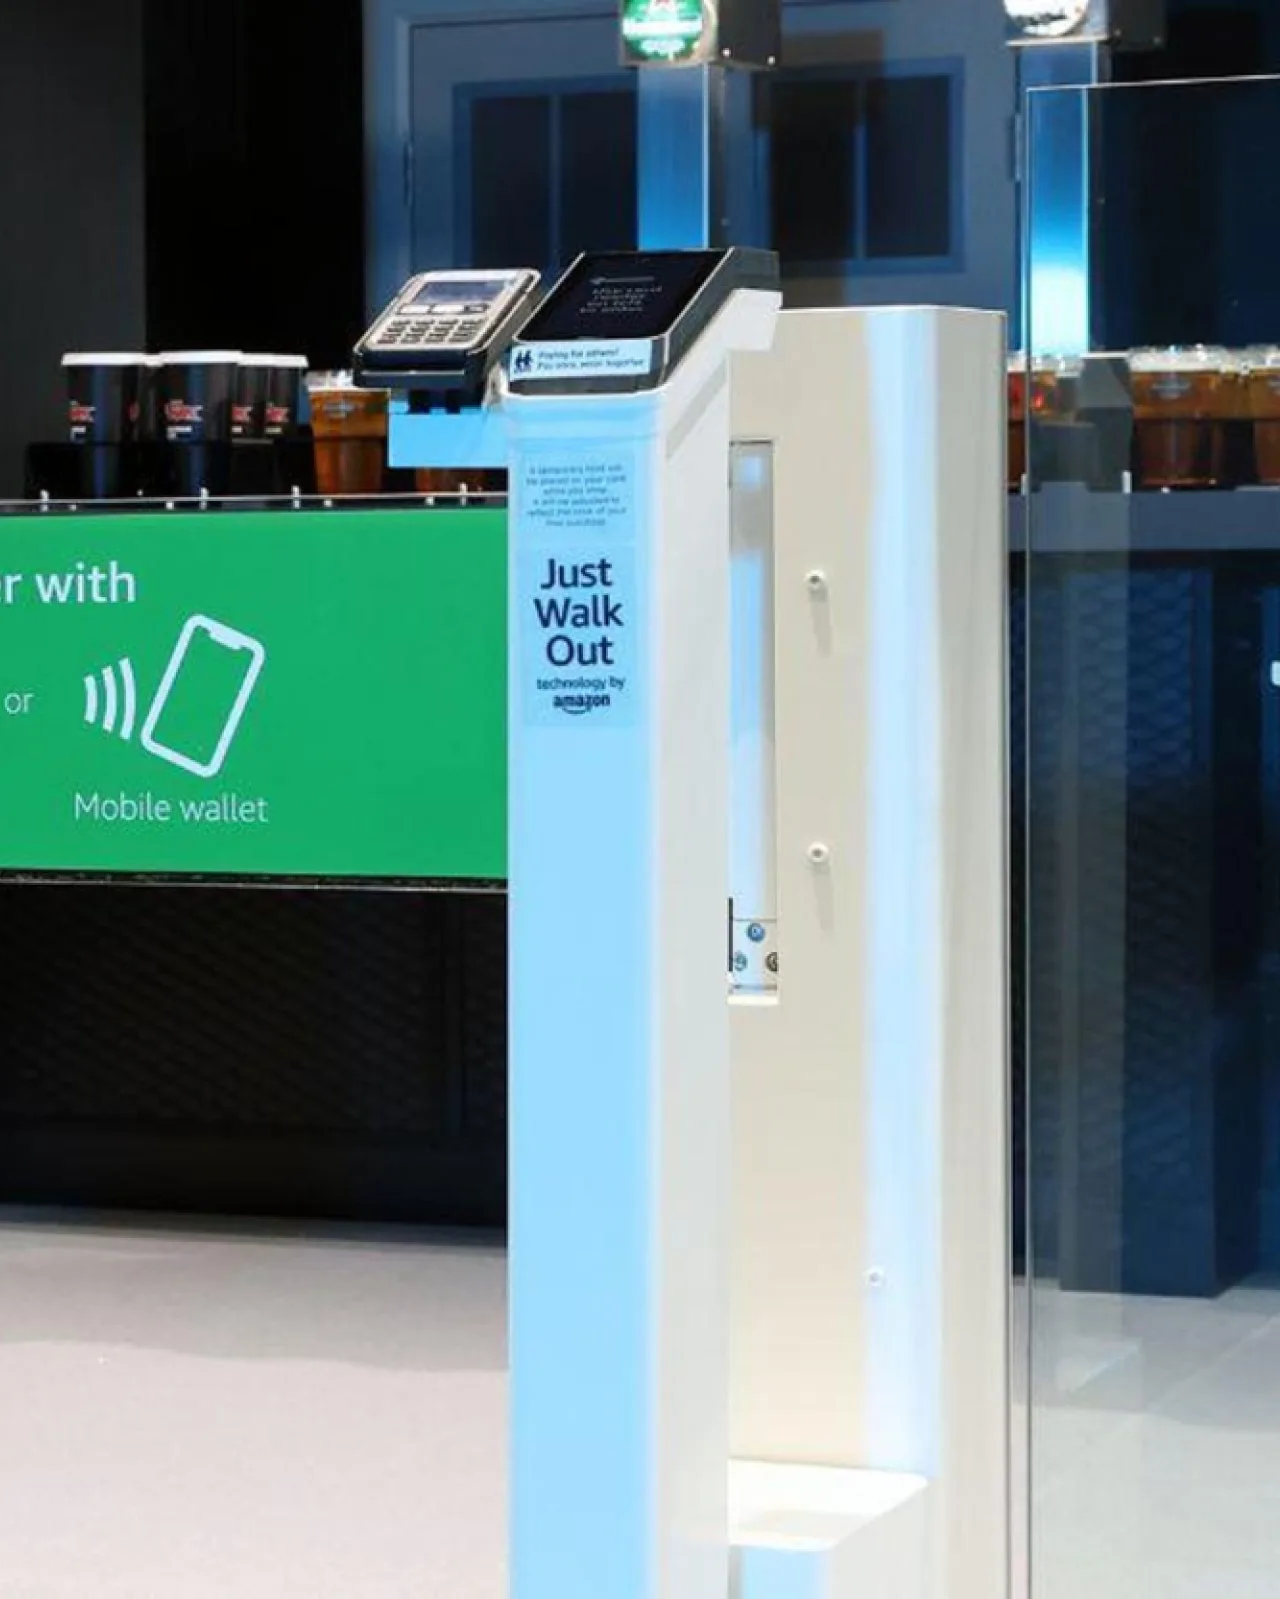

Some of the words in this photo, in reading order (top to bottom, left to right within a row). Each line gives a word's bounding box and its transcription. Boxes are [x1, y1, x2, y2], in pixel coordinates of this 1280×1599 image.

[36, 561, 137, 604] with
[540, 557, 613, 590] Just
[533, 593, 625, 629] Walk
[546, 634, 615, 667] Out
[536, 676, 607, 691] technology
[609, 674, 626, 691] by
[4, 690, 35, 714] or
[552, 693, 611, 712] amazon
[74, 791, 171, 822] Mobile
[178, 794, 269, 823] wallet
